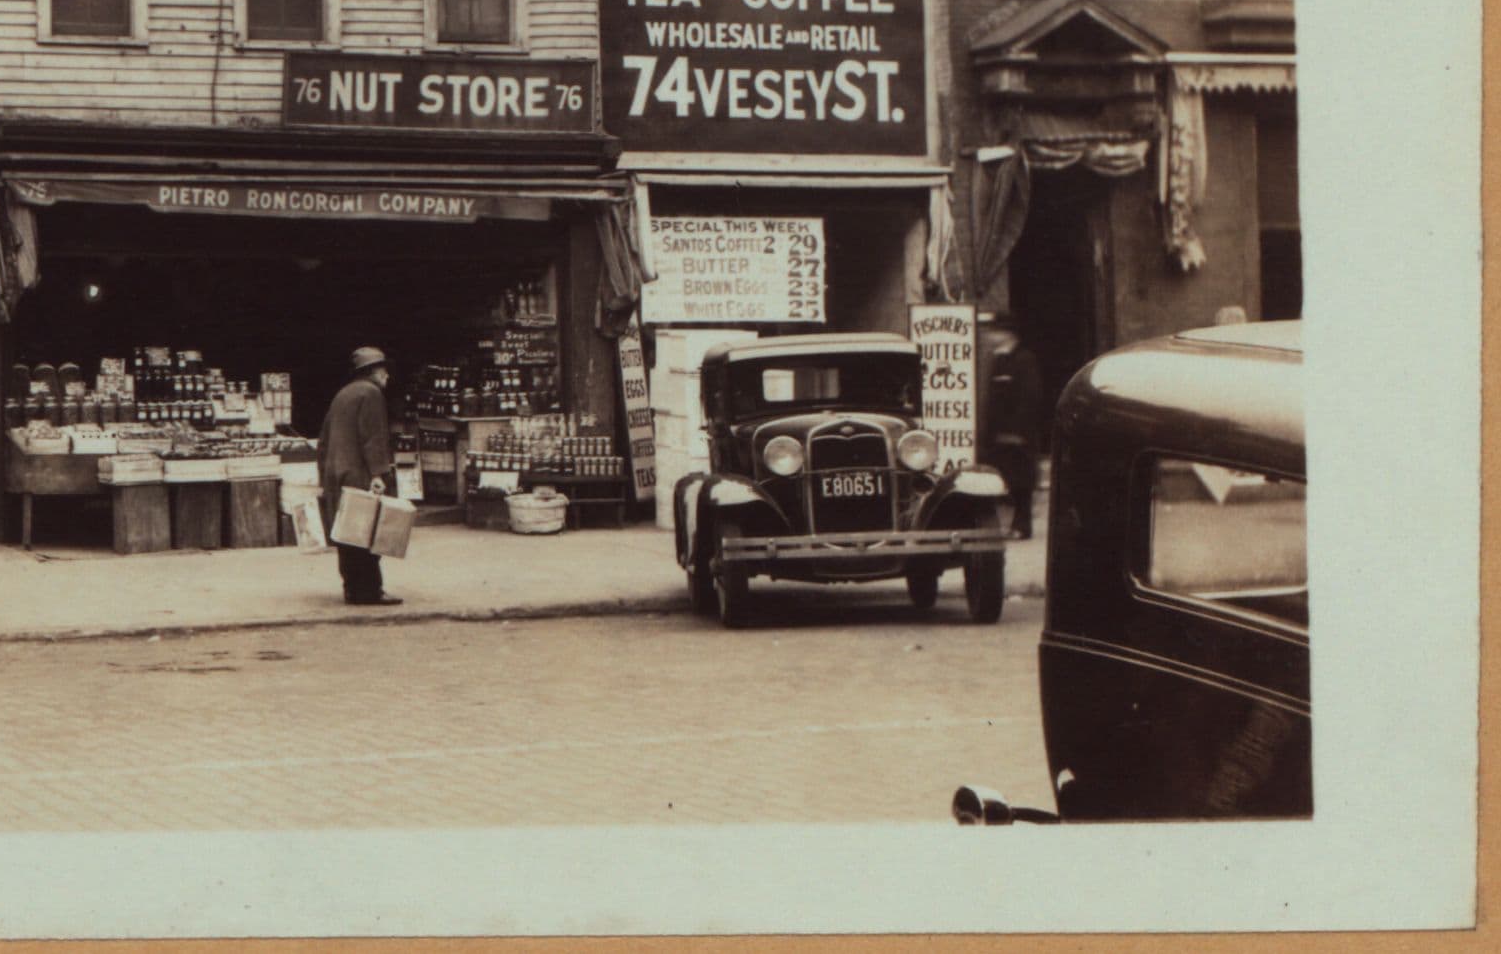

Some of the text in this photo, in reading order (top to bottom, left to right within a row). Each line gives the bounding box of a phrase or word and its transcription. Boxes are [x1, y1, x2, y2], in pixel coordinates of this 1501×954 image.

[645, 21, 880, 52] WHOLESALE AND RETAIL
[294, 71, 583, 118] 76 NUT STORE 76
[158, 185, 476, 216] PIETRO RONCORONI COMPANY
[650, 219, 811, 234] SPECIAL THIS WEEK
[662, 236, 712, 253] SANTOS
[788, 234, 819, 256] 29
[682, 257, 750, 275] BUTTER
[787, 257, 821, 278] 27
[683, 279, 733, 296] BROWN
[787, 279, 820, 298] 23
[683, 300, 723, 318] WHITE
[787, 300, 820, 319] 25
[625, 378, 646, 399] EGGS
[924, 400, 970, 419] HEESE
[635, 467, 656, 489] TEAS
